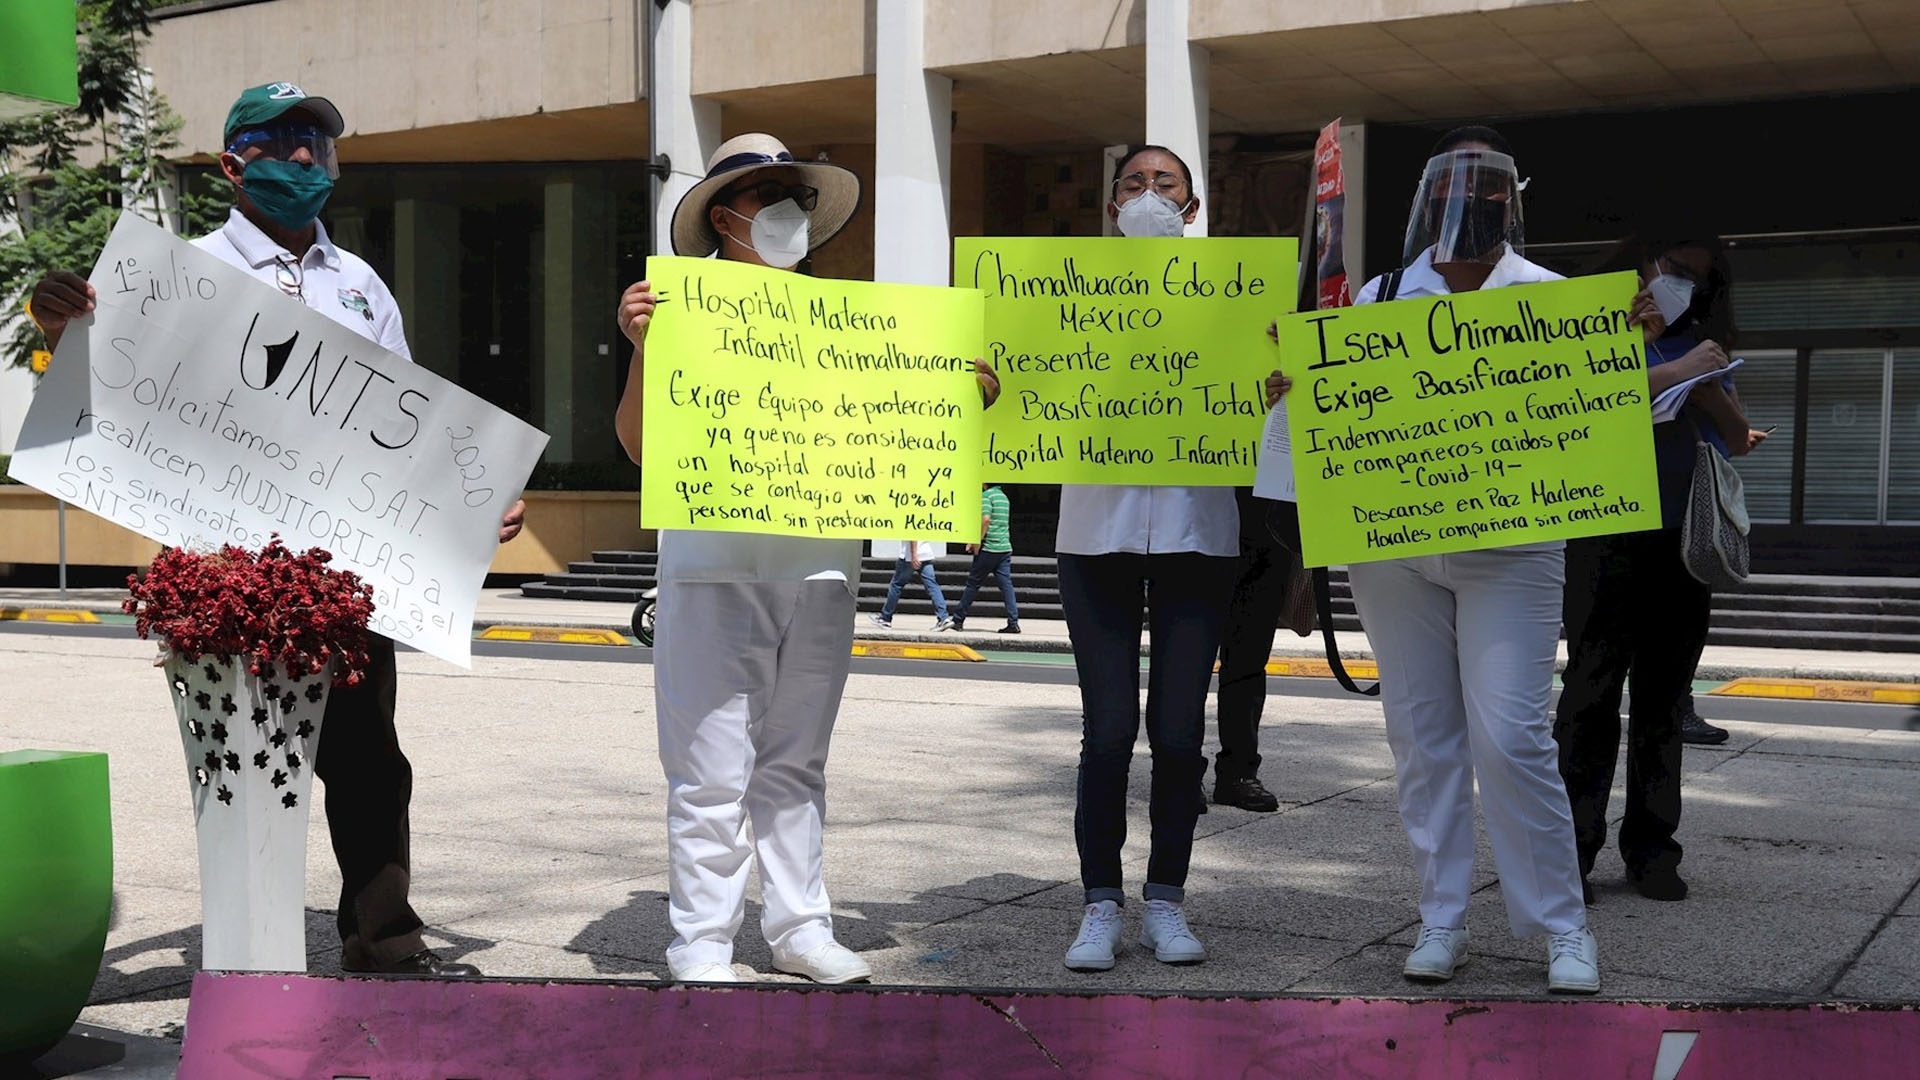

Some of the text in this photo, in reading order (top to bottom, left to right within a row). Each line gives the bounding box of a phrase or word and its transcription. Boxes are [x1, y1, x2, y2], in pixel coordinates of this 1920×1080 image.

[141, 249, 217, 317] julio
[974, 250, 1265, 300] Chimalhuacán Edo de
[685, 276, 797, 324] Hospital
[810, 297, 897, 331] Materno
[1060, 303, 1162, 333] México
[1427, 300, 1632, 354] Chimalhuacán
[713, 326, 805, 369] Infantil
[990, 342, 1199, 386] Presente exige
[670, 369, 740, 419] Exige
[759, 382, 823, 422] Equipo
[834, 394, 857, 418] de
[1020, 380, 1266, 420] Basificación Total
[1313, 344, 1641, 420] Exige Basificacion total
[92, 337, 301, 471] Solicitamos
[309, 455, 343, 491] al
[1305, 408, 1494, 454] Indemnizacion
[1506, 409, 1518, 423] a
[1526, 388, 1641, 421] familiares
[707, 426, 732, 449] ya
[814, 433, 836, 447] es
[846, 430, 957, 452] considerado
[1080, 437, 1153, 464] Materno
[1168, 435, 1257, 467] Infantil
[1322, 425, 1590, 479] de compañeros caidos por
[678, 455, 707, 471] un
[730, 451, 810, 485] hospital
[928, 465, 952, 487] ya
[75, 408, 440, 606] realicen AUDITORIAS a
[731, 483, 754, 497] se
[768, 481, 842, 504] contagio
[855, 492, 875, 505] un
[890, 490, 926, 508] 40%
[931, 489, 954, 507] del
[1354, 481, 1604, 523] Descanse en Paz Marlene
[64, 436, 114, 484] los
[128, 479, 262, 548] sindicatos
[432, 611, 454, 635] el
[784, 510, 807, 528] sin
[817, 510, 893, 533] prestacion
[1368, 527, 1431, 549] Morales
[1439, 516, 1528, 539] compañera
[1535, 513, 1561, 526] sin
